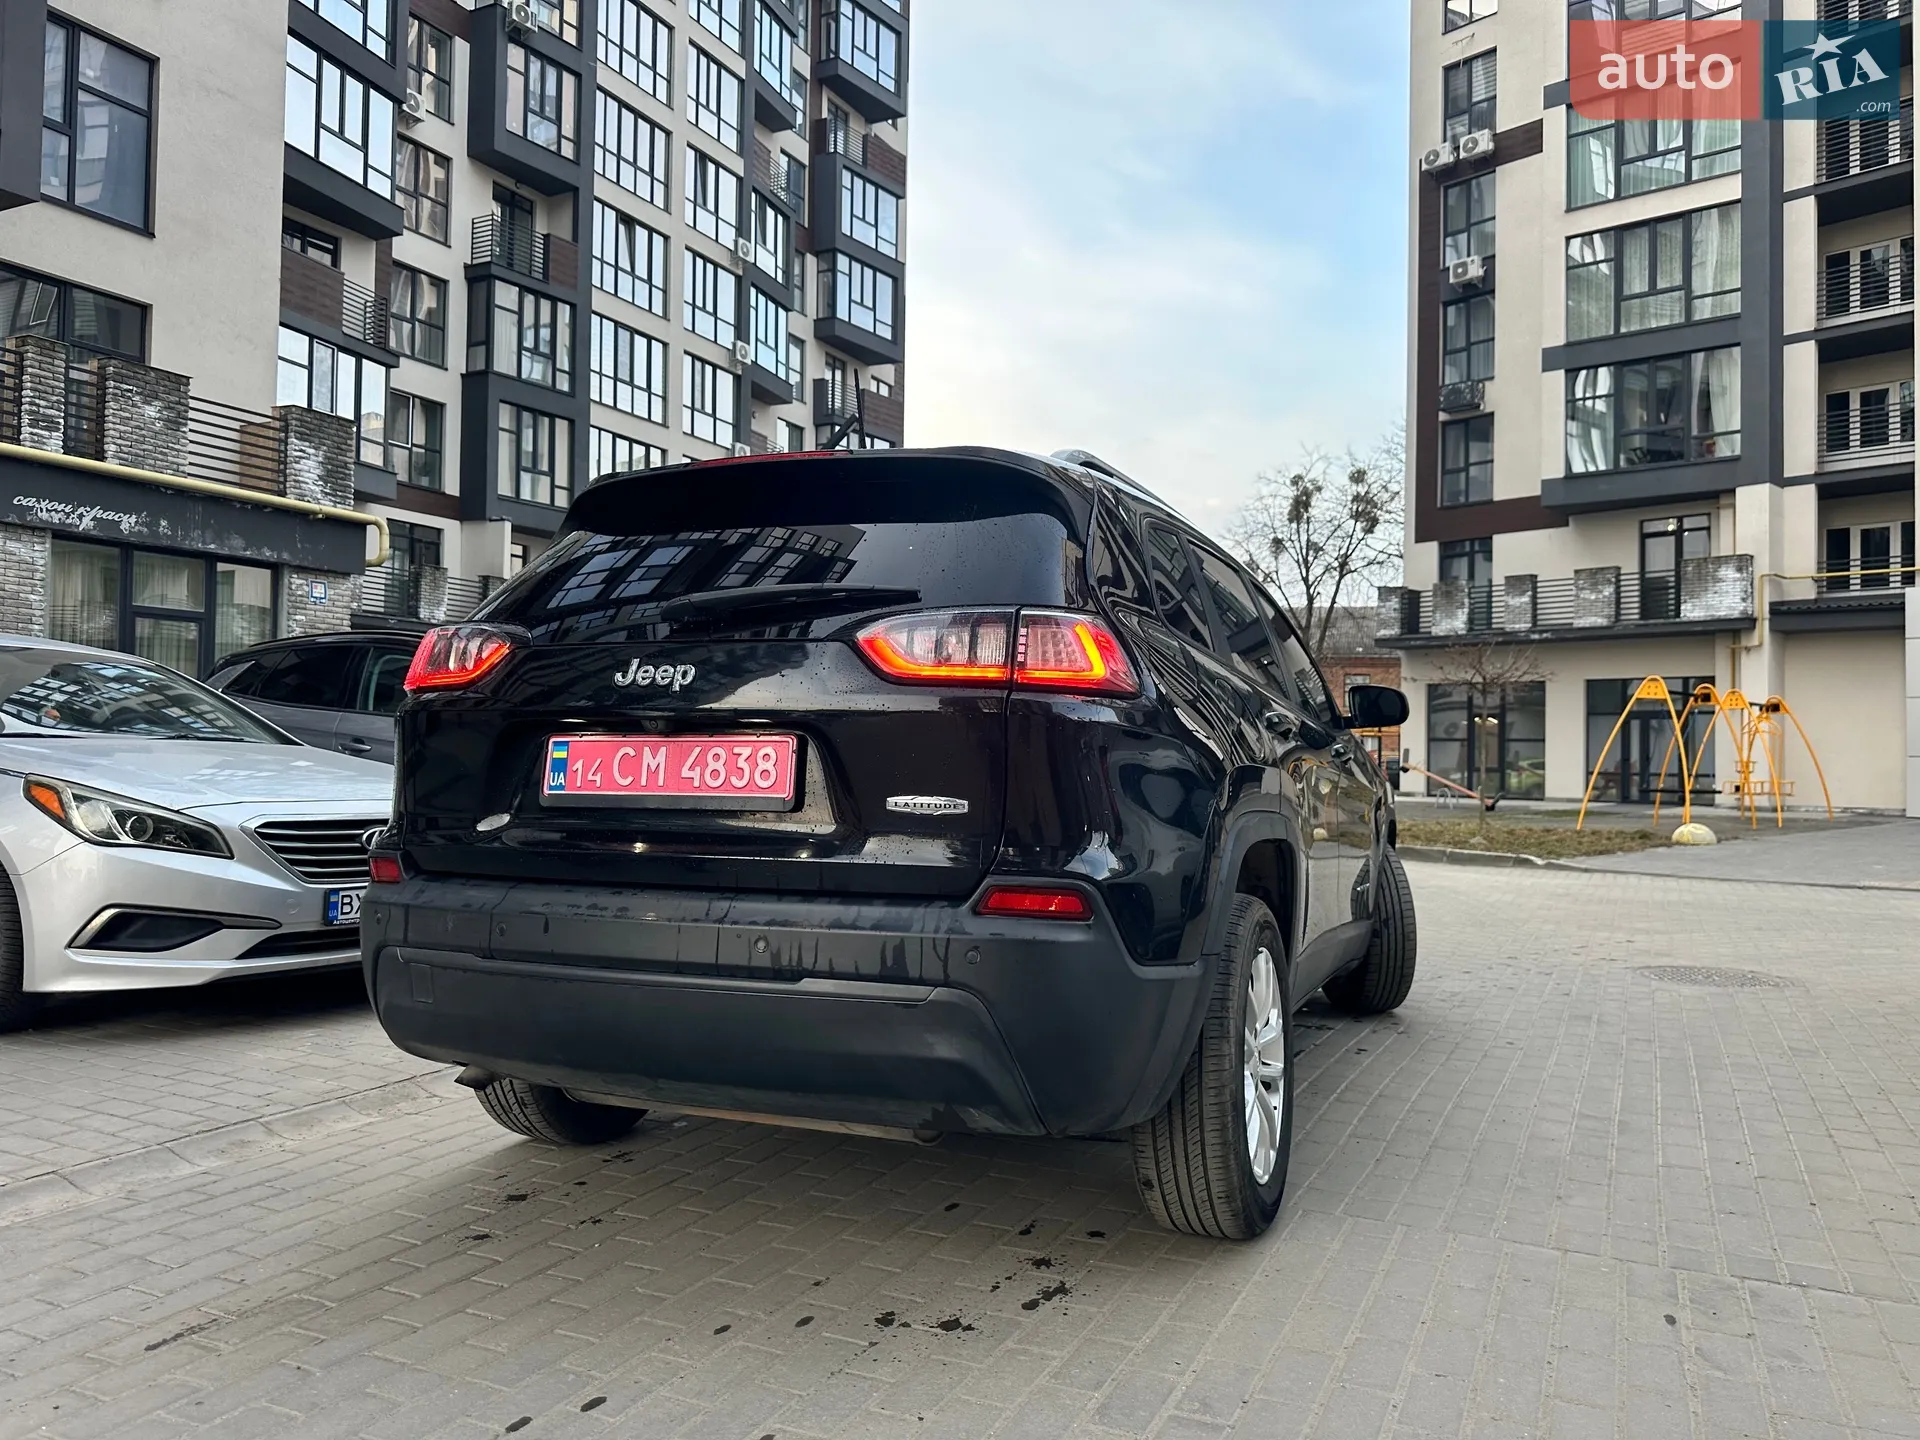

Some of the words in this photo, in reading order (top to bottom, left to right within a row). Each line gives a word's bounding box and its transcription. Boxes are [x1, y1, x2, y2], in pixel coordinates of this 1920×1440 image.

[614, 658, 696, 692] Jeep
[571, 758, 603, 788] 14
[612, 746, 667, 788] CM
[681, 745, 778, 790] 4838
[550, 773, 565, 786] UA
[894, 801, 966, 810] LATITUDE
[328, 909, 338, 917] UA
